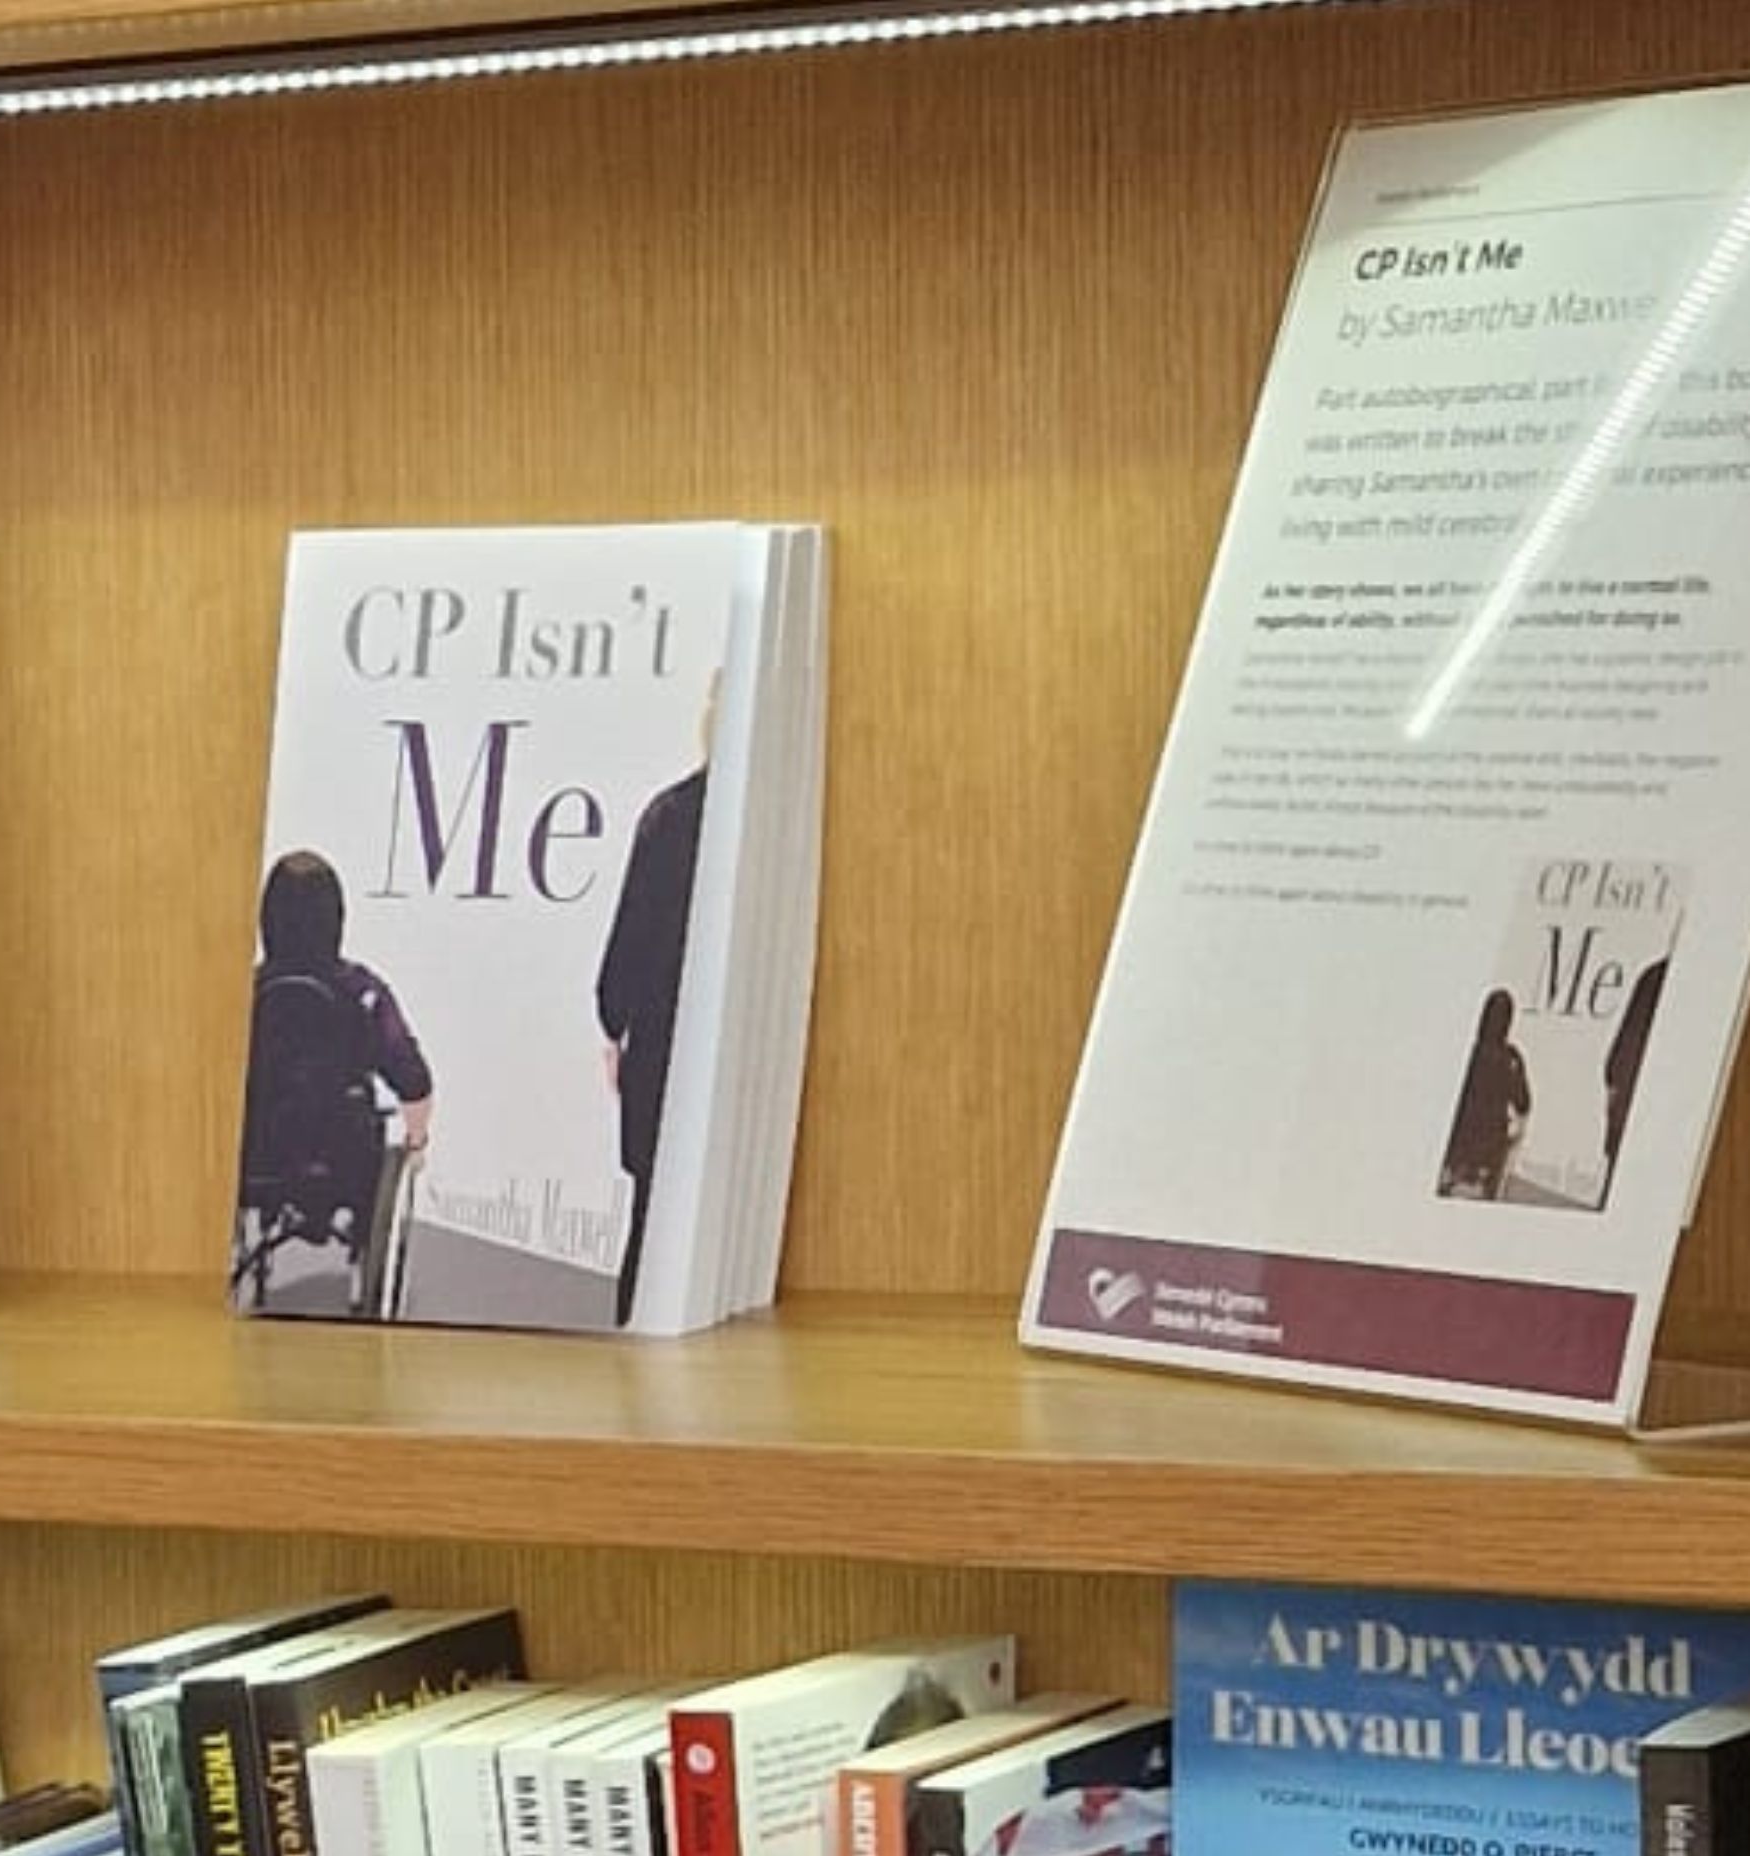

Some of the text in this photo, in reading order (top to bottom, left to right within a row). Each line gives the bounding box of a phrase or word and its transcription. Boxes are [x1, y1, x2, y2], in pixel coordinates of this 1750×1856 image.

[1355, 239, 1524, 281] CP Isn't Me
[1337, 308, 1375, 347] by
[1378, 298, 1536, 340] Samantha
[344, 584, 676, 681] CP Isn't
[365, 719, 604, 902] Me
[1536, 860, 1670, 913] CP Isn't
[1521, 924, 1625, 1019] Me
[1252, 1611, 1692, 1706] Ar Drywydd
[1210, 1690, 1443, 1761] Enwau
[199, 1732, 240, 1834] TWENTY
[511, 1773, 542, 1846] MANY
[562, 1777, 591, 1850] MANY
